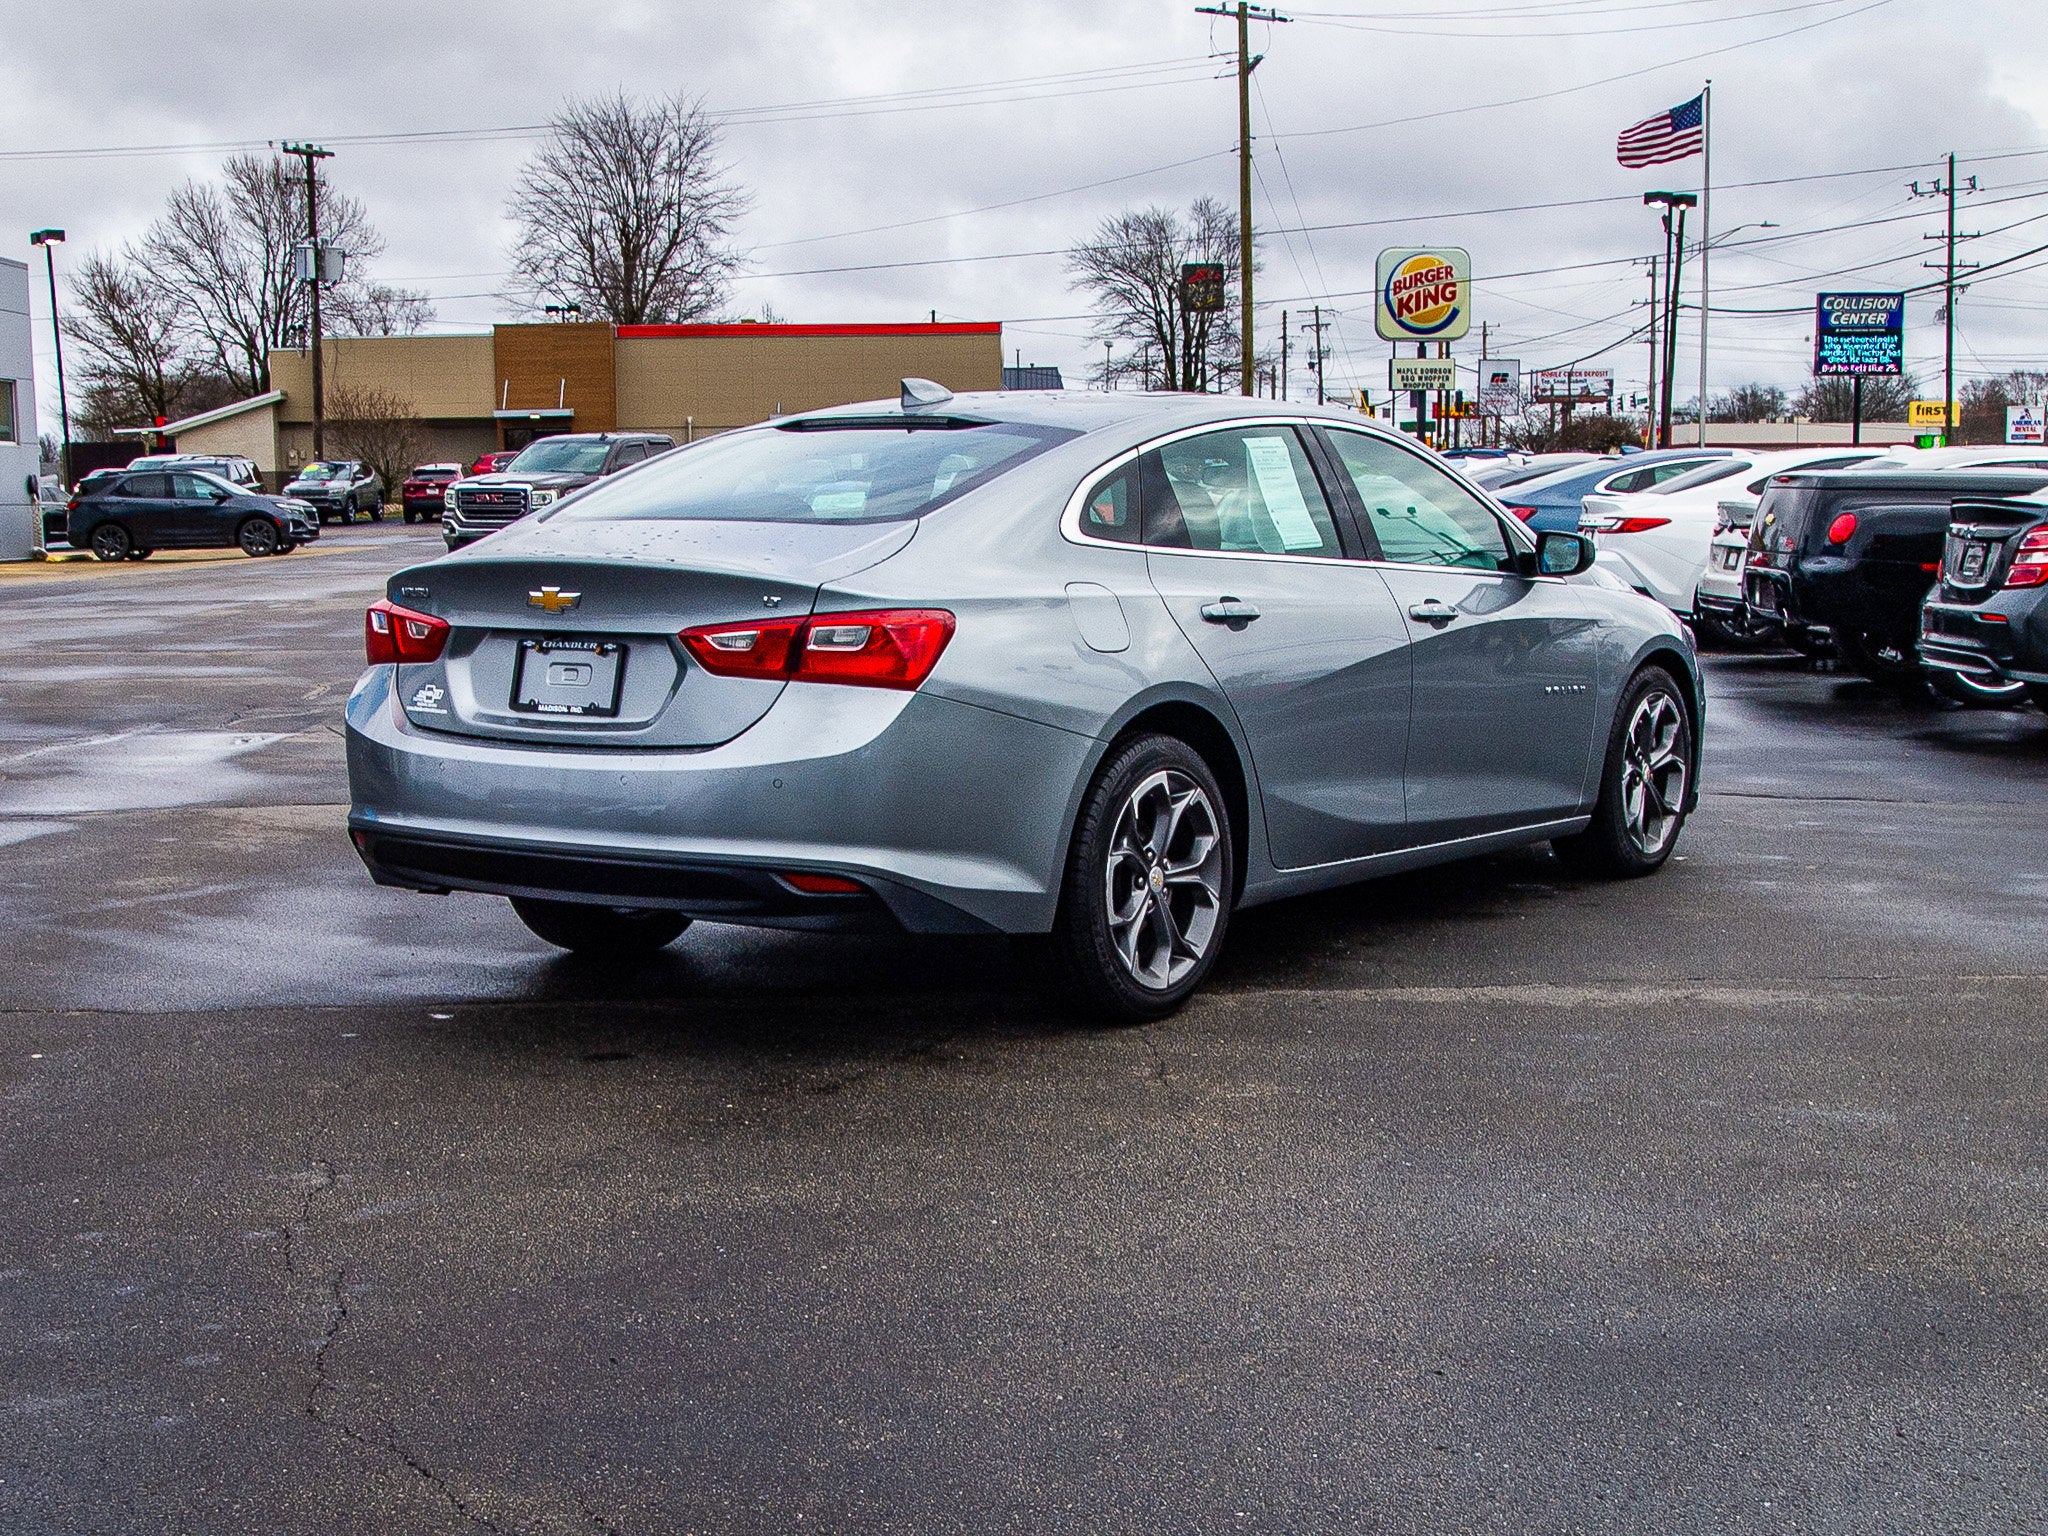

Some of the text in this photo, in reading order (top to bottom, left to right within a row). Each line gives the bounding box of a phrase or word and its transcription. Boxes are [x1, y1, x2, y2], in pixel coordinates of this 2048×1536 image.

[1393, 265, 1454, 296] BURGER
[1396, 281, 1457, 319] KING
[1823, 297, 1898, 310] COLLISION
[1830, 312, 1887, 325] CENTER
[1396, 367, 1452, 375] MAPLE BOURBON
[475, 493, 504, 503] GMC
[763, 595, 782, 607] LT
[542, 640, 598, 649] CHANDLER
